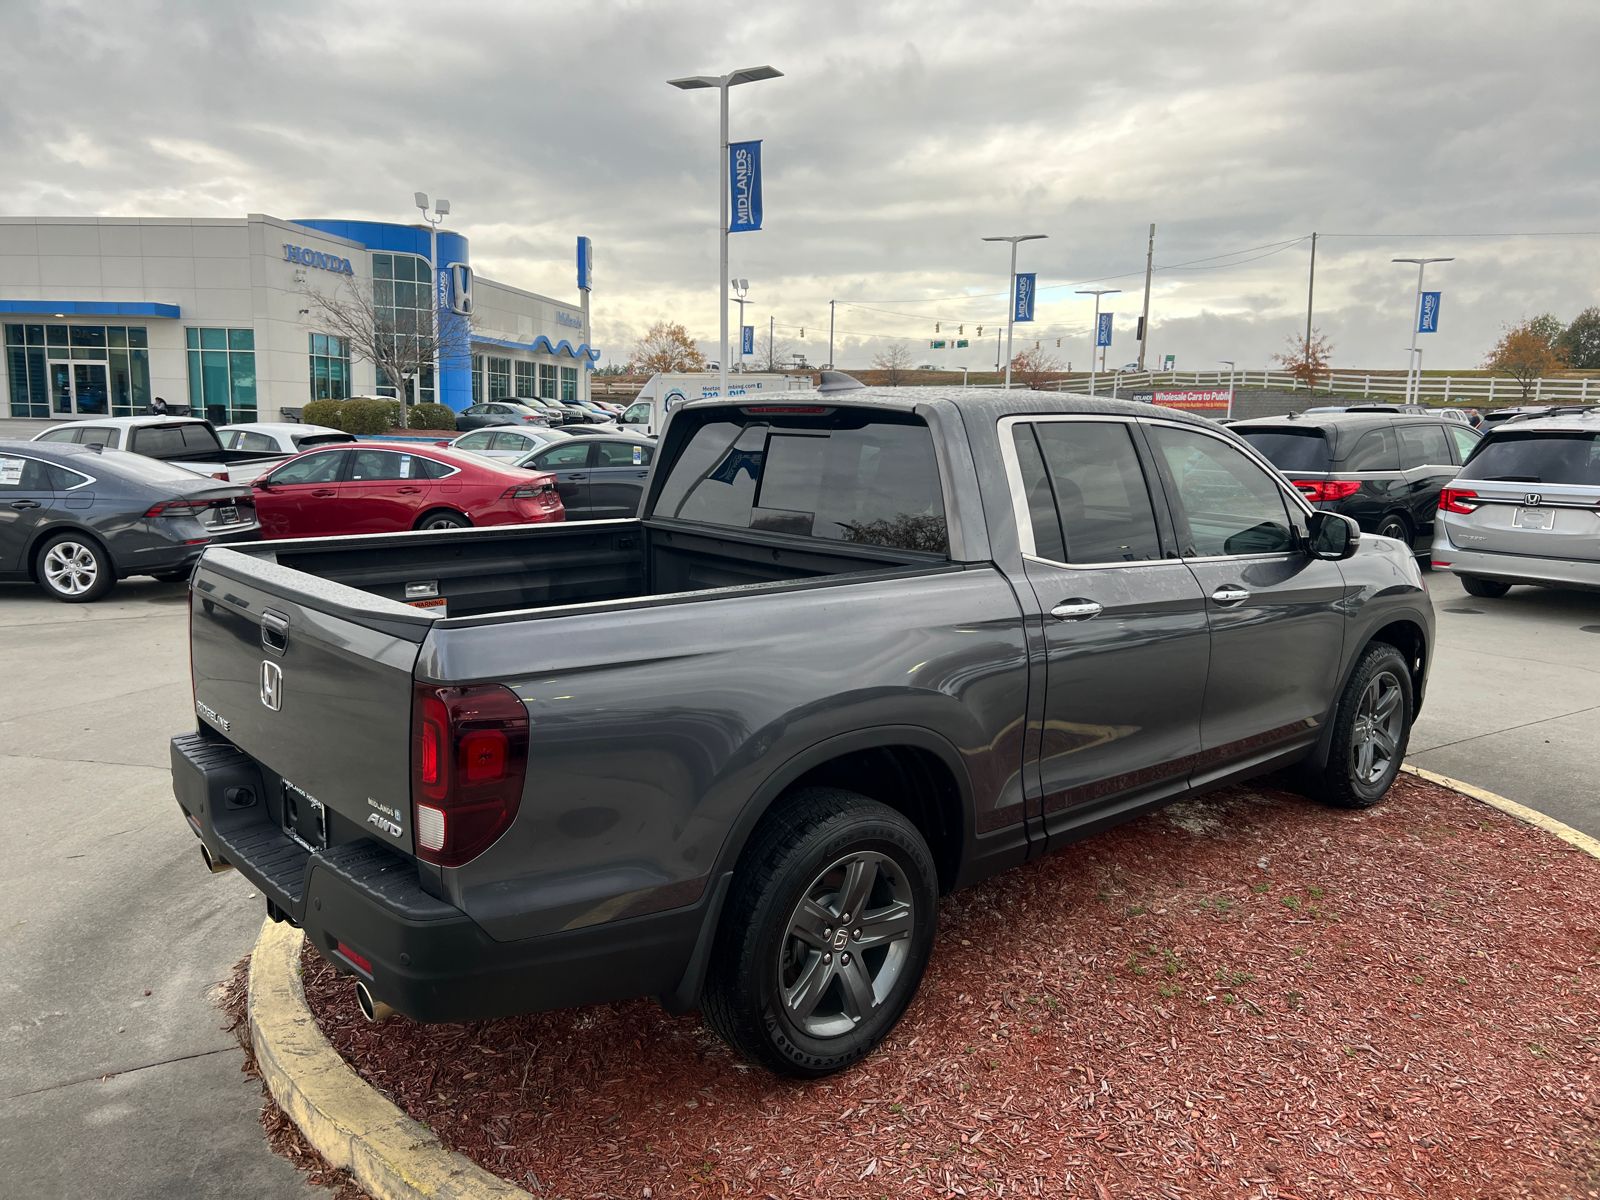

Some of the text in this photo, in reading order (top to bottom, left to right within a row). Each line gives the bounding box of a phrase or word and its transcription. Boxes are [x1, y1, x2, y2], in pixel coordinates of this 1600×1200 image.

[735, 149, 748, 224] MIDLANDS
[284, 243, 354, 275] HONDA
[1018, 276, 1027, 317] MIDLANDS
[1422, 294, 1433, 329] MIDLANDS
[1156, 392, 1187, 401] Wholesale
[1187, 392, 1202, 401] Cars
[1203, 392, 1211, 401] to
[414, 599, 444, 608] WARNING
[196, 700, 230, 731] RIDGELINE
[367, 797, 394, 817] MIDLANDS
[367, 813, 403, 838] AWD
[776, 1035, 863, 1067] Firestone
